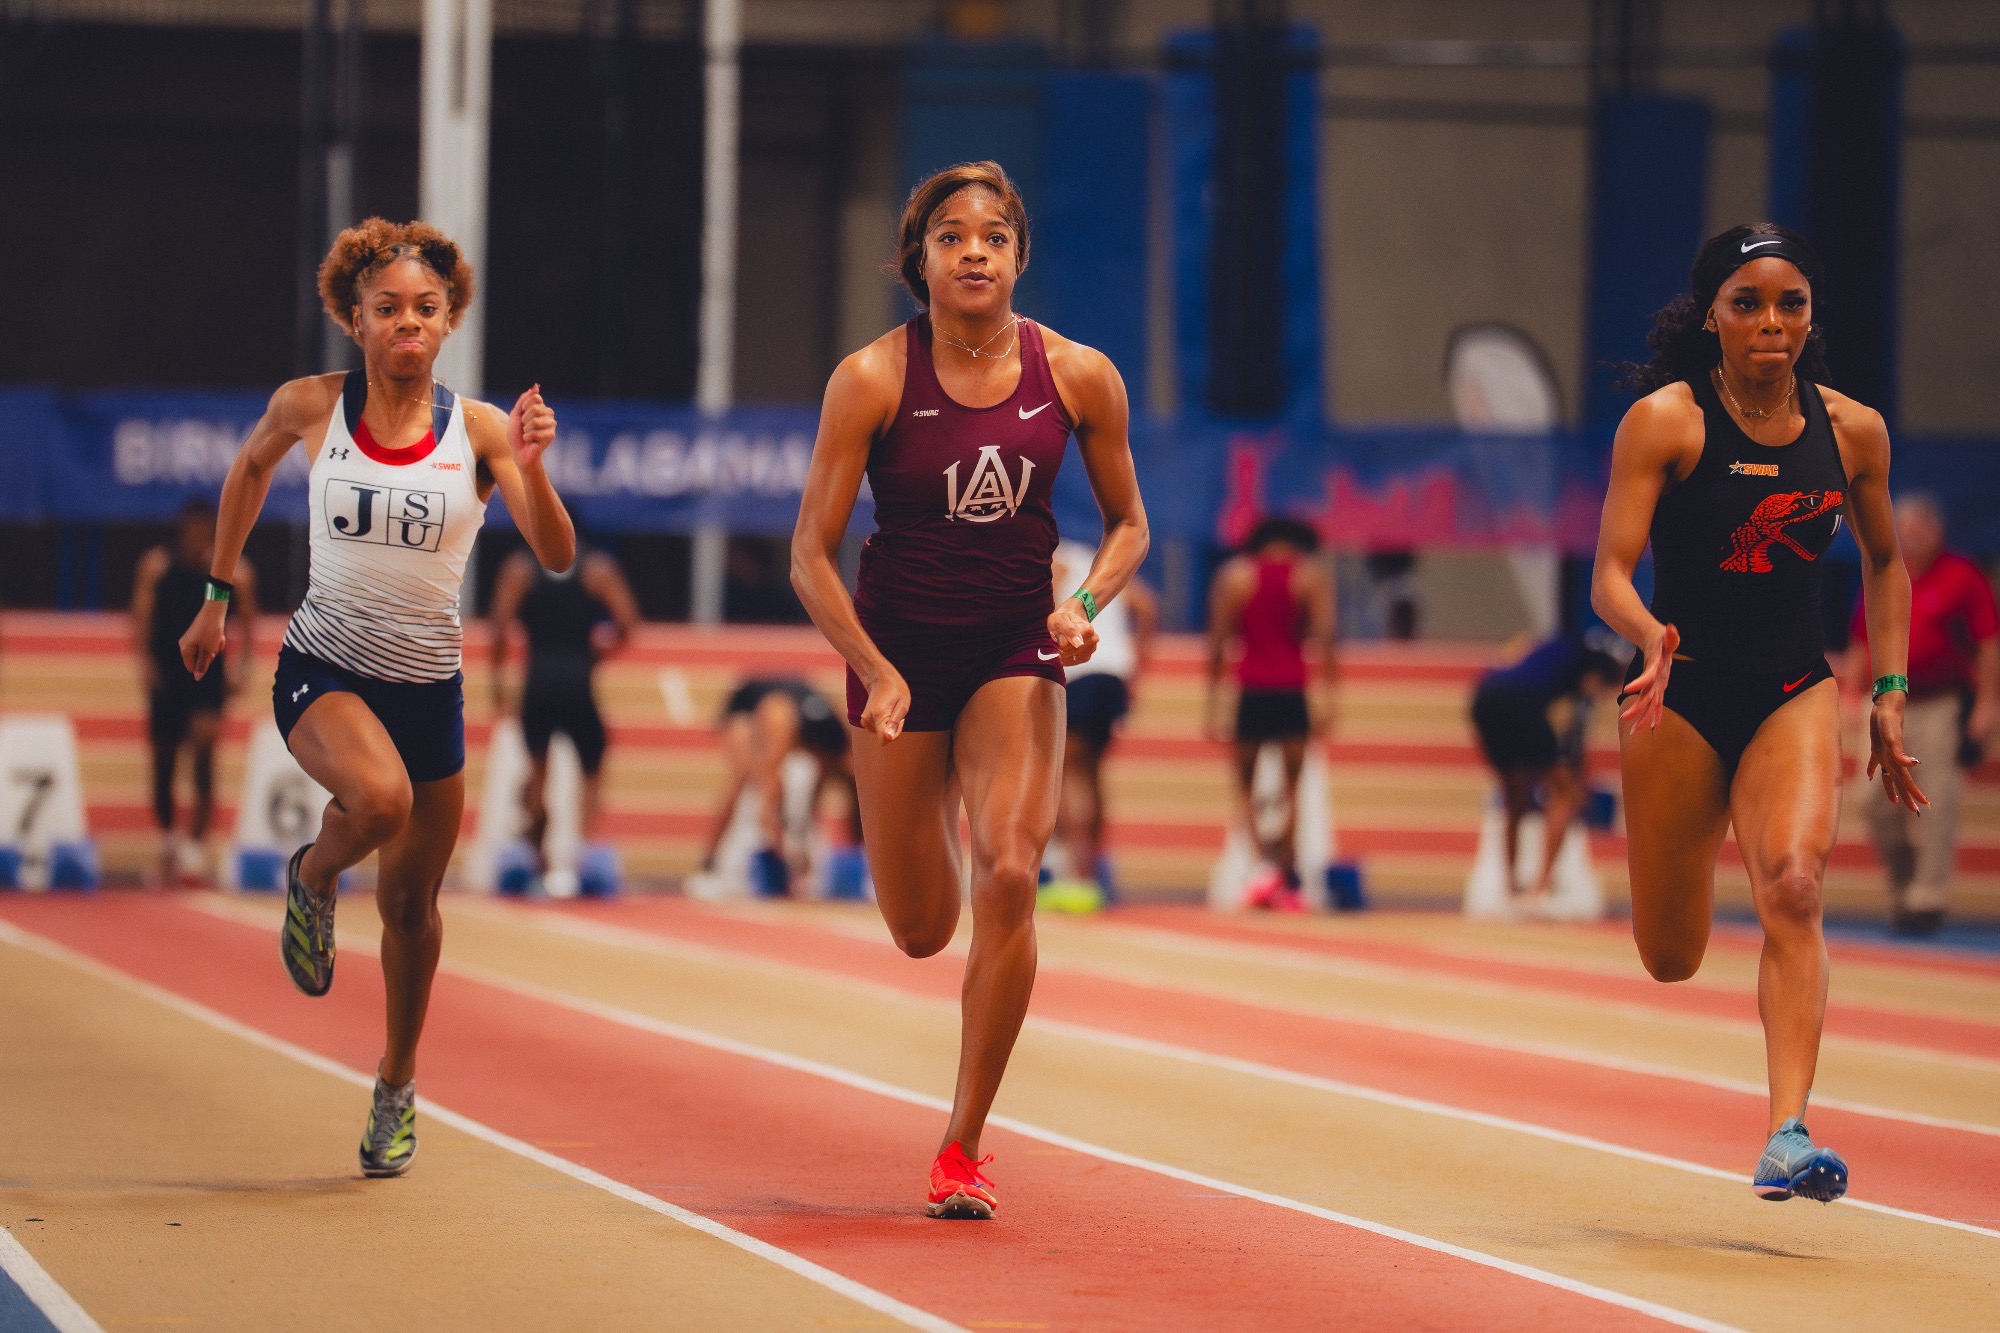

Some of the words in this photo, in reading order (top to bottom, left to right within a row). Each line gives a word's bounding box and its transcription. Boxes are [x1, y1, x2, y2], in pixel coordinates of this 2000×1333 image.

[919, 409, 940, 417] SWAC
[437, 462, 462, 471] SWAC
[1743, 463, 1779, 477] SWAC
[12, 766, 55, 836] 7
[266, 772, 313, 843] 6
